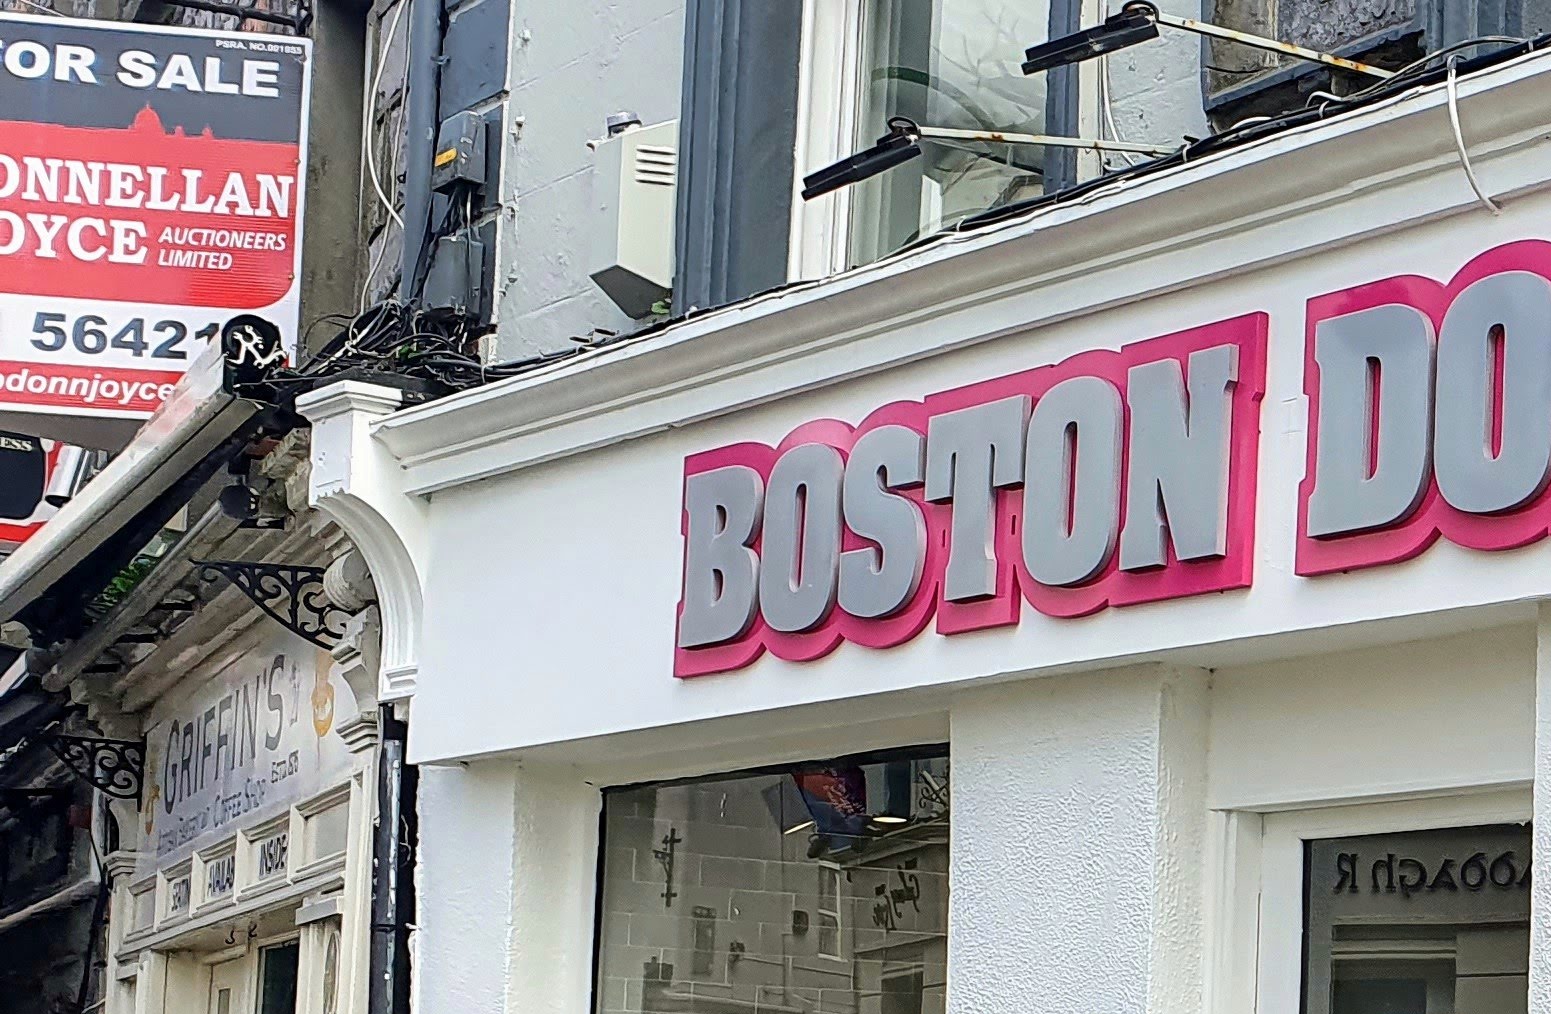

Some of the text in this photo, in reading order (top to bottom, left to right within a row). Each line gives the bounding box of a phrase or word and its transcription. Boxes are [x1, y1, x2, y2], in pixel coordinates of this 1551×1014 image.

[0, 39, 280, 98] OR SALE
[158, 226, 287, 251] AUCTIONEERS
[158, 249, 233, 271] LIMITED
[679, 342, 1240, 650] BOSTON
[163, 654, 286, 815] GRIFFIN'S
